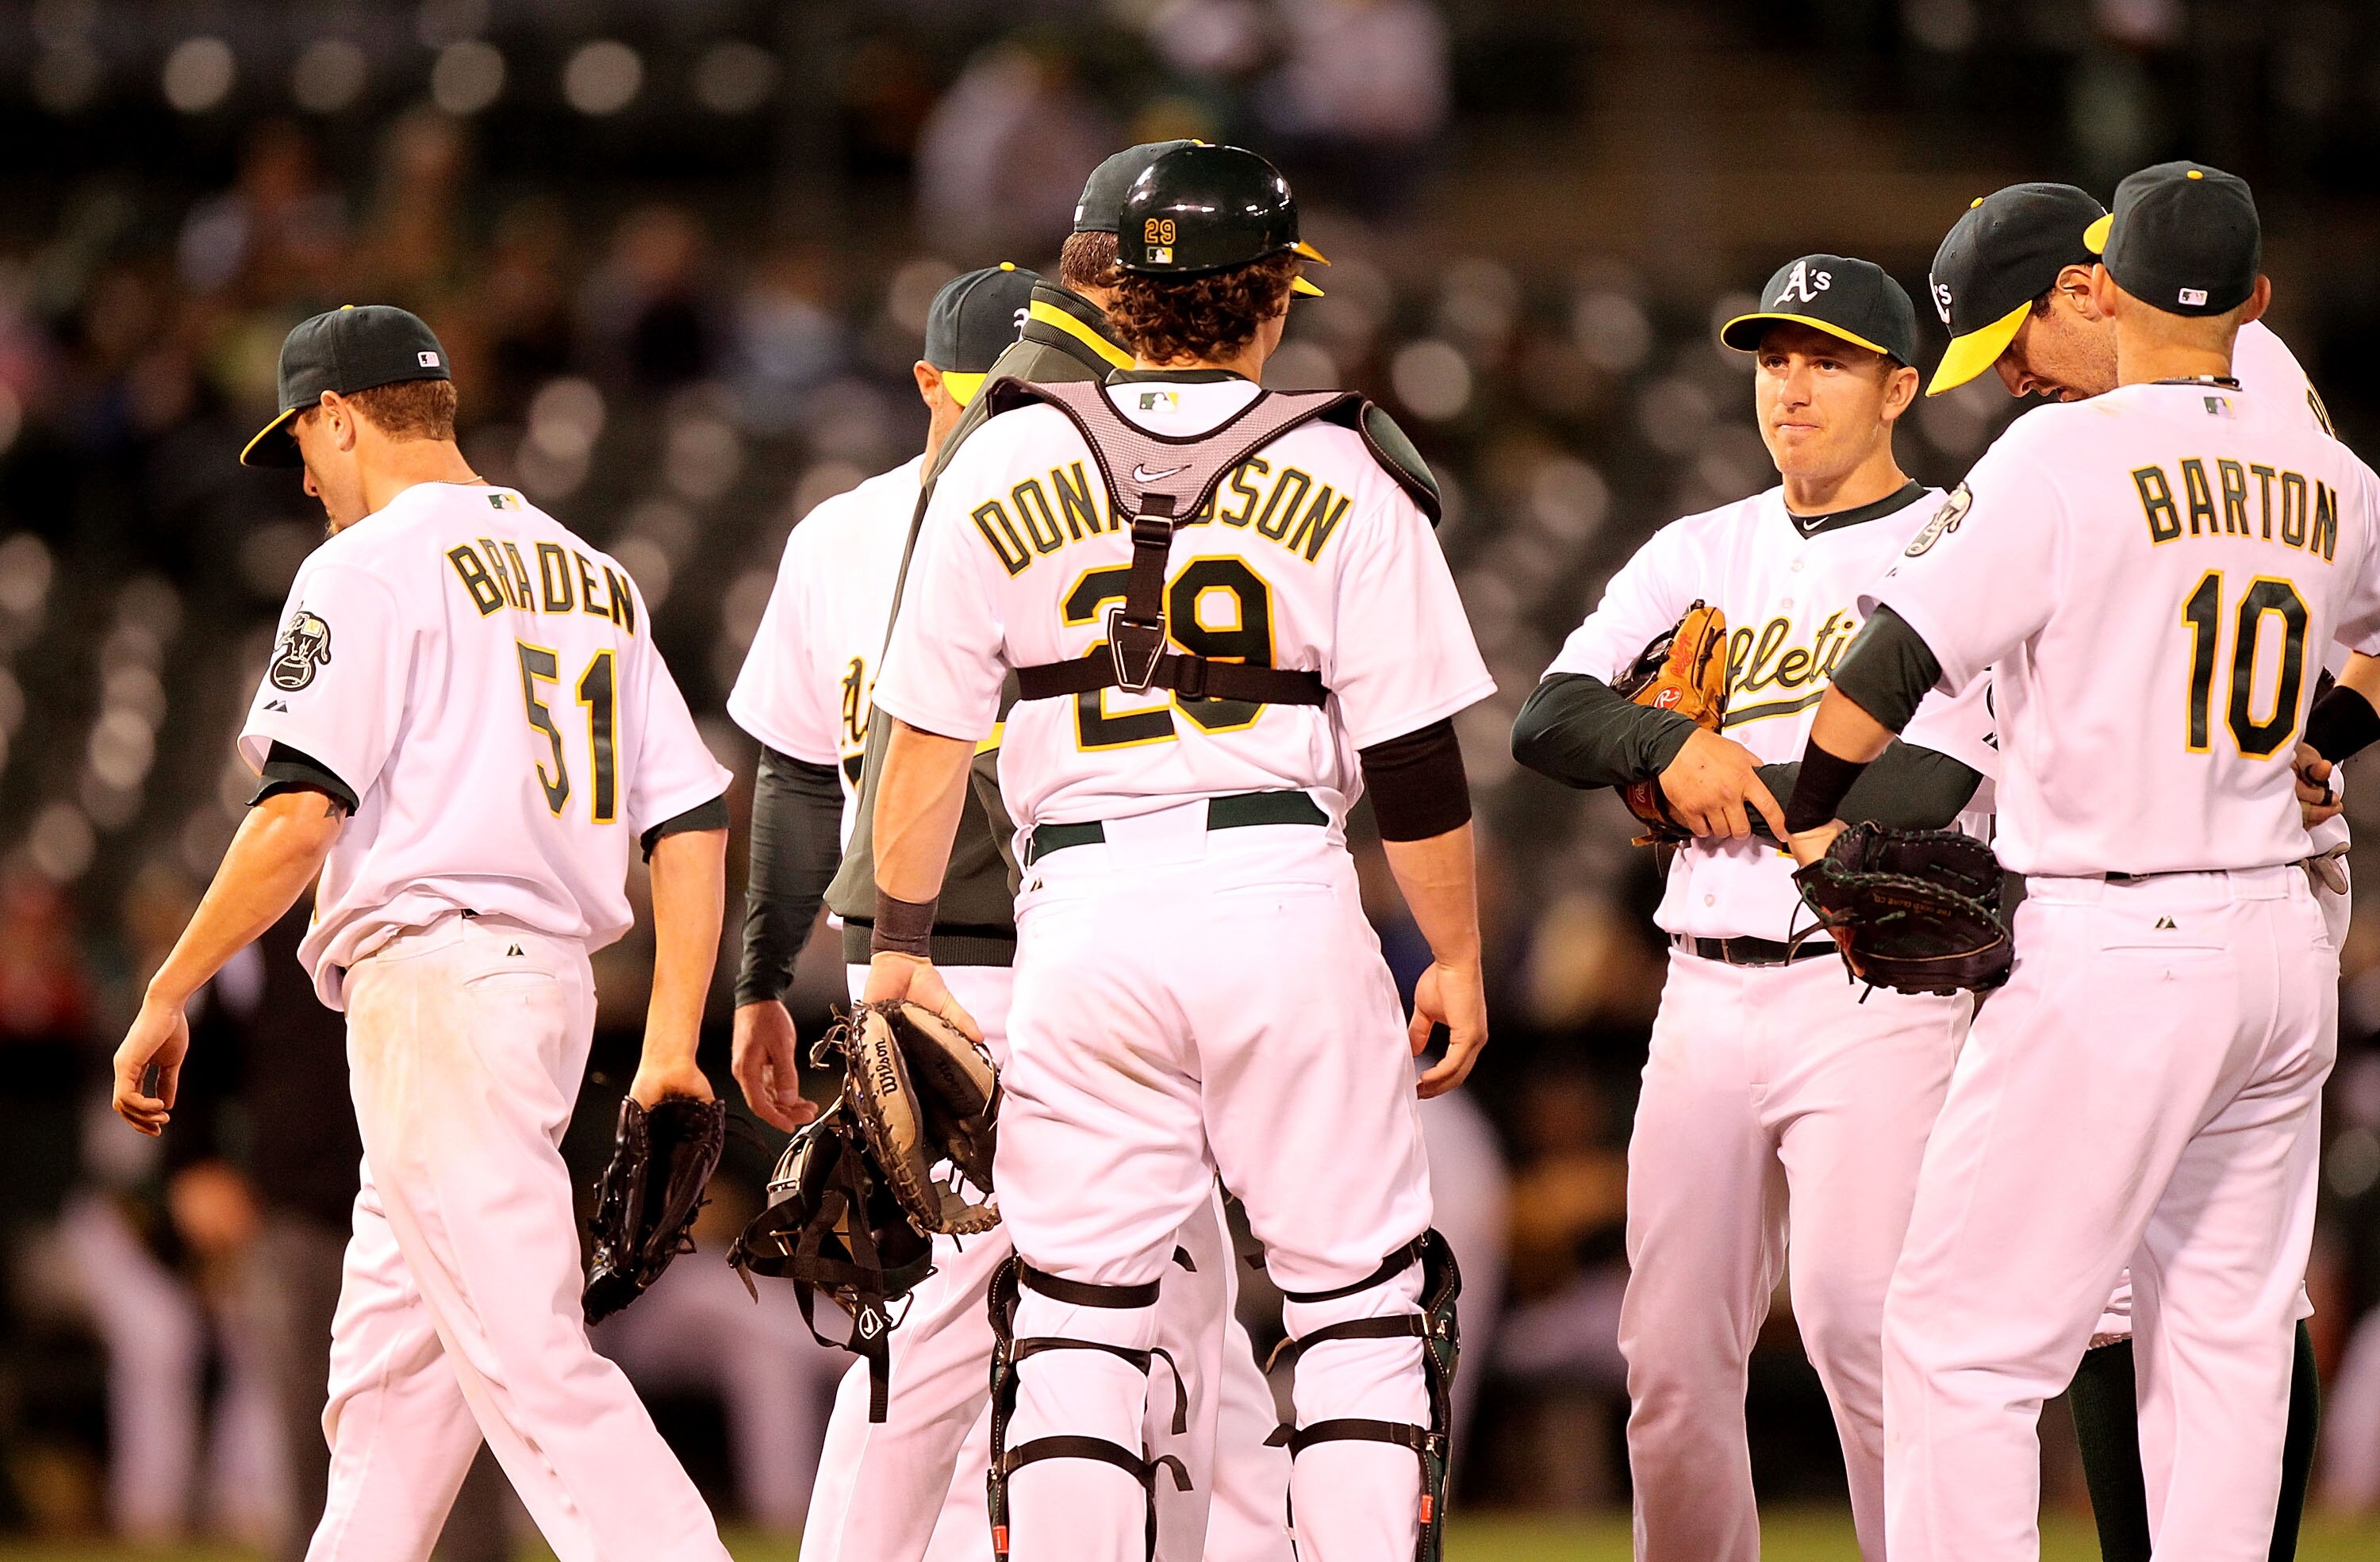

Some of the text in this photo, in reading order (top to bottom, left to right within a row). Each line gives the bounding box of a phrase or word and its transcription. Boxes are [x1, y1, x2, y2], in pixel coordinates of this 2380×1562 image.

[1144, 217, 1177, 245] 29
[1772, 260, 1833, 308] A's
[971, 455, 1359, 581] DONSON
[2130, 456, 2338, 566] BARTON
[445, 537, 637, 639] BRADEN
[1060, 554, 1277, 753] 29
[2180, 568, 2312, 762] 10
[515, 634, 618, 826] 51
[874, 1037, 898, 1098] Wilson
